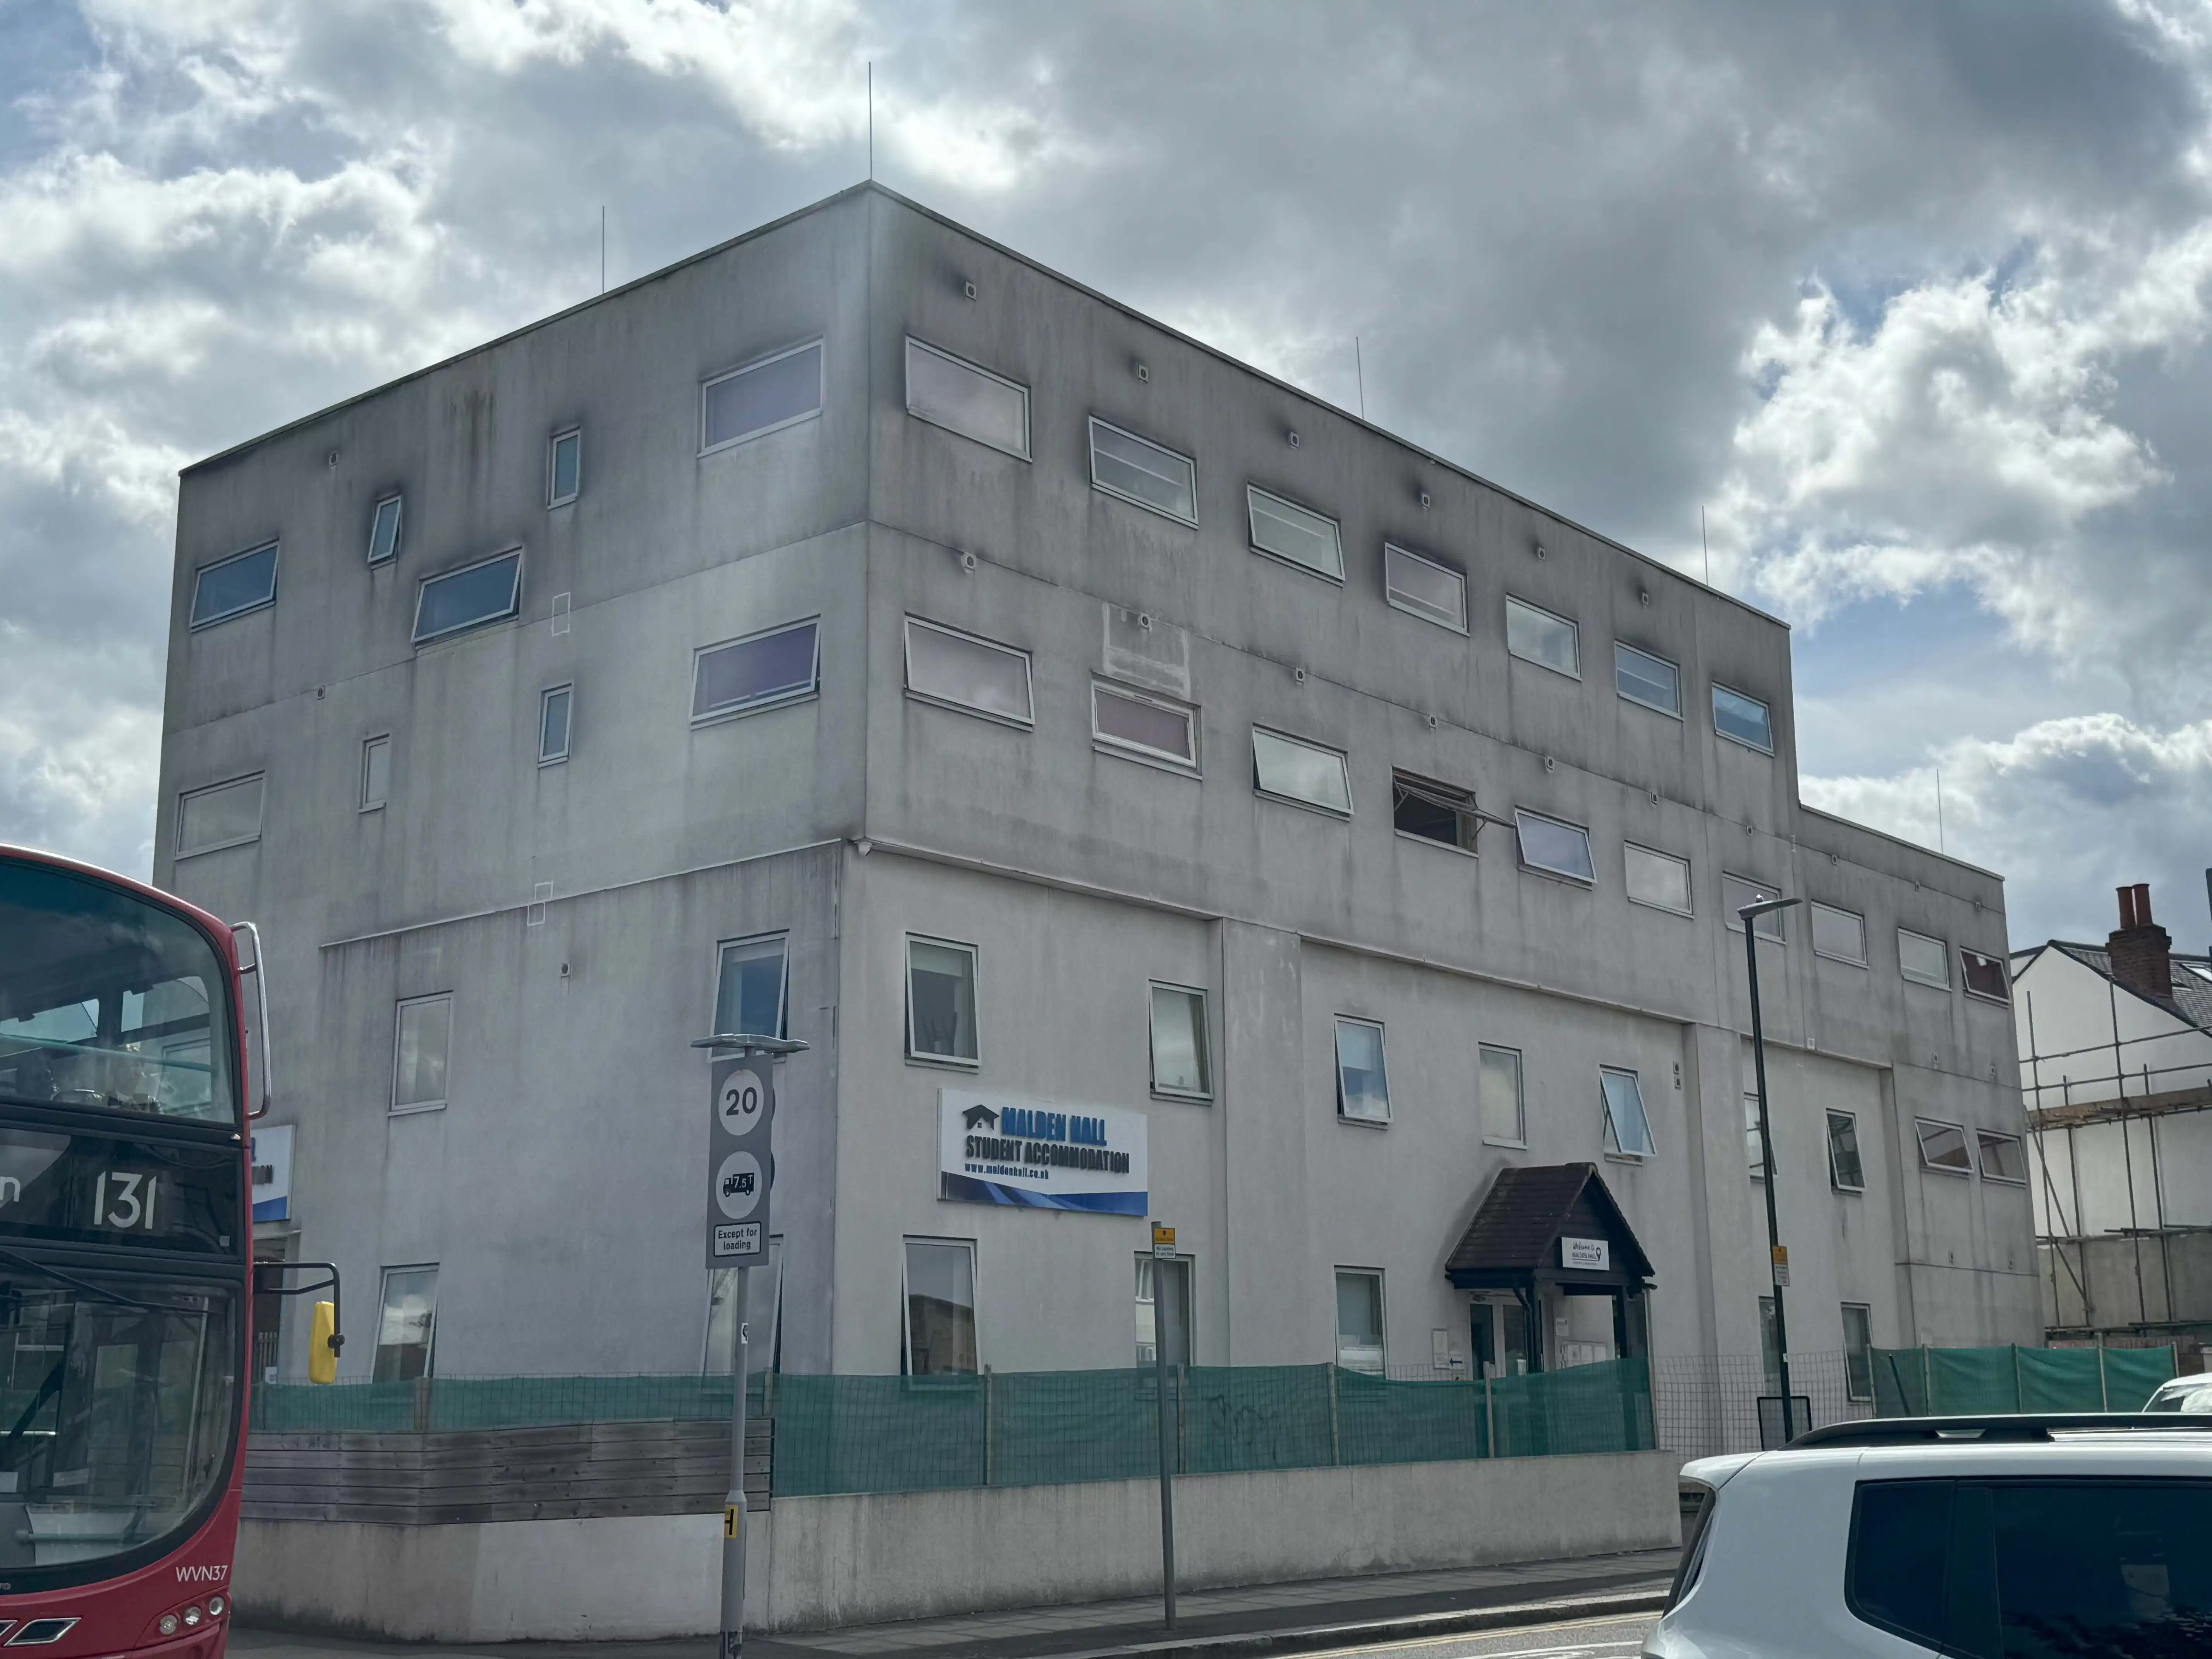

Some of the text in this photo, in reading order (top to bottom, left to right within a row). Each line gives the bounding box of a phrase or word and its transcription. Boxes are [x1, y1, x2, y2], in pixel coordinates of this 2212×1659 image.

[726, 1087, 757, 1116] 20
[1001, 1107, 1107, 1146] MALDEN HALL
[966, 1135, 1129, 1173] STUDENT ACCOMMODATION
[94, 1171, 157, 1229] 131
[718, 1228, 757, 1239] Except for
[723, 1240, 751, 1250] loading
[175, 1565, 228, 1582] WVN37
